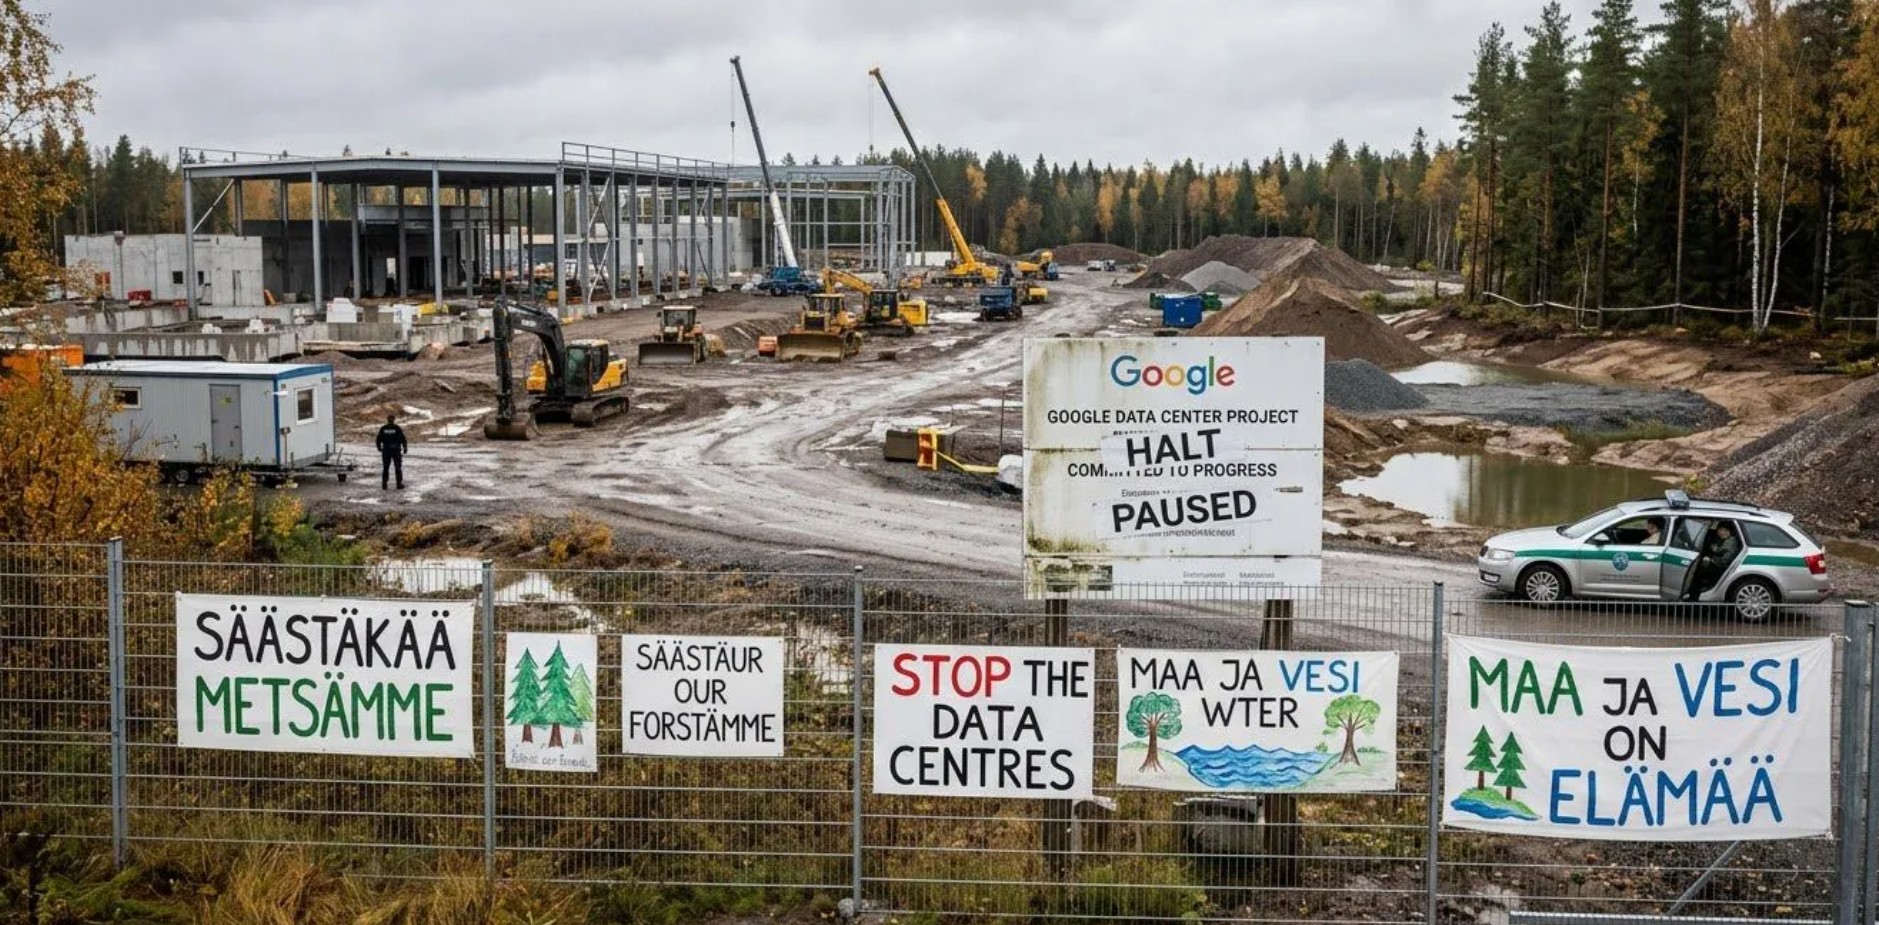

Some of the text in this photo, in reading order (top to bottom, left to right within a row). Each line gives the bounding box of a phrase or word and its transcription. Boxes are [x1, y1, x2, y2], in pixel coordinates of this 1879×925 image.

[1110, 354, 1235, 395] Google
[1047, 409, 1299, 424] GOOGLE DATA CENTER PROJECT
[1125, 427, 1222, 467] HALT
[1193, 463, 1278, 477] PROGRESS
[1112, 489, 1258, 533] PAUSED
[194, 604, 456, 670] SÄÄSTÄKÄÄ
[635, 640, 764, 674] SÄÄSTÄUR
[891, 652, 1089, 699] STOP THE
[1131, 657, 1360, 693] MAA JA VESI
[195, 671, 454, 741] METSÄMME
[674, 678, 727, 705] OUR
[1468, 655, 1800, 718] MAA JA VESI
[629, 708, 776, 742] FORSTÄMME
[932, 703, 1044, 742] DATA
[1201, 697, 1299, 728] WTER
[1603, 725, 1667, 761] ON
[889, 744, 1075, 791] CENTRES
[1549, 754, 1783, 827] ELÄMÄÄ
